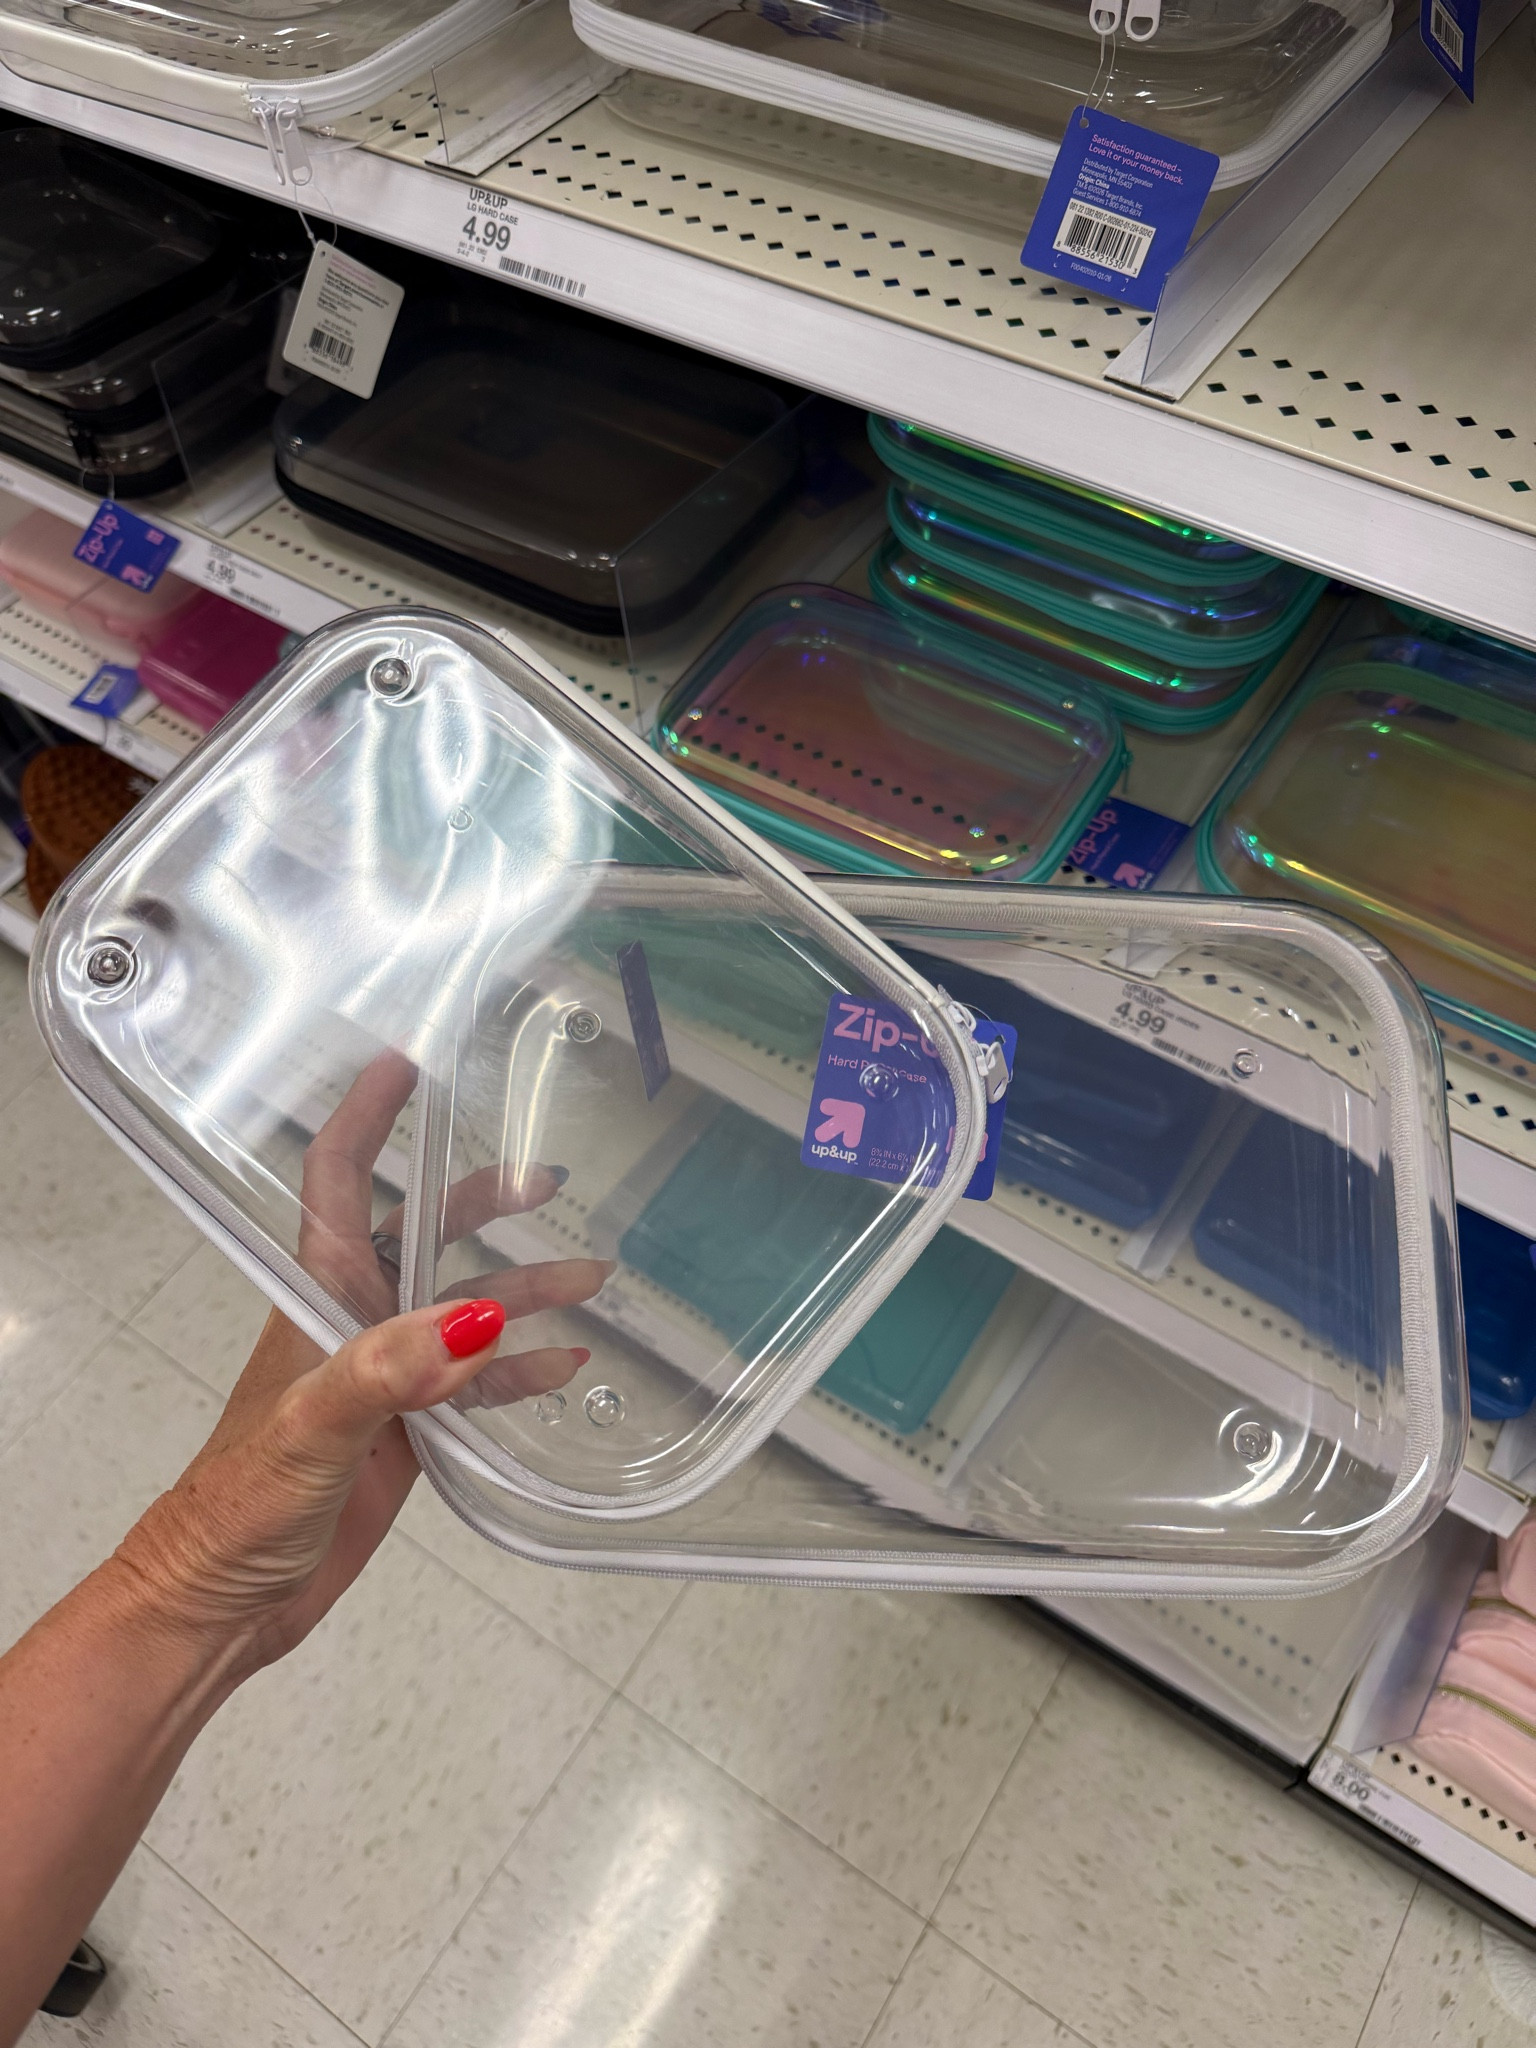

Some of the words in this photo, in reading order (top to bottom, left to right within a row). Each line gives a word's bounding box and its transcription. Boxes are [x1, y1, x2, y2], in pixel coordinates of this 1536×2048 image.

[1088, 142, 1107, 156] Love
[1105, 149, 1113, 159] it
[1112, 153, 1122, 161] or
[1121, 156, 1139, 168] your
[1138, 163, 1165, 179] money
[1163, 170, 1184, 185] back.
[1091, 133, 1135, 156] Satisfaction
[1134, 151, 1178, 172] guaranteed
[1077, 172, 1096, 184] Origin:
[1094, 178, 1110, 189] China
[1080, 164, 1108, 181] Minneapolis,
[1083, 157, 1109, 172] Distributed
[1107, 166, 1114, 176] by
[1111, 167, 1129, 183] Target
[1127, 173, 1153, 188] Corporation
[469, 187, 508, 209] UP&UP
[1072, 186, 1087, 198] Guest
[1085, 191, 1105, 205] Services
[1104, 190, 1120, 204] Target
[1117, 195, 1135, 208] Brands,
[1134, 202, 1143, 210] Inc.
[466, 201, 477, 212] LG
[477, 205, 499, 219] HARD
[498, 211, 519, 226] CASE
[462, 215, 511, 251] 4.99
[1070, 245, 1096, 260] 88556
[1132, 267, 1138, 275] 3
[1115, 1001, 1166, 1034] 4.99
[827, 1053, 859, 1069] Hard
[812, 1143, 857, 1164] up&up
[887, 1162, 899, 1170] cm
